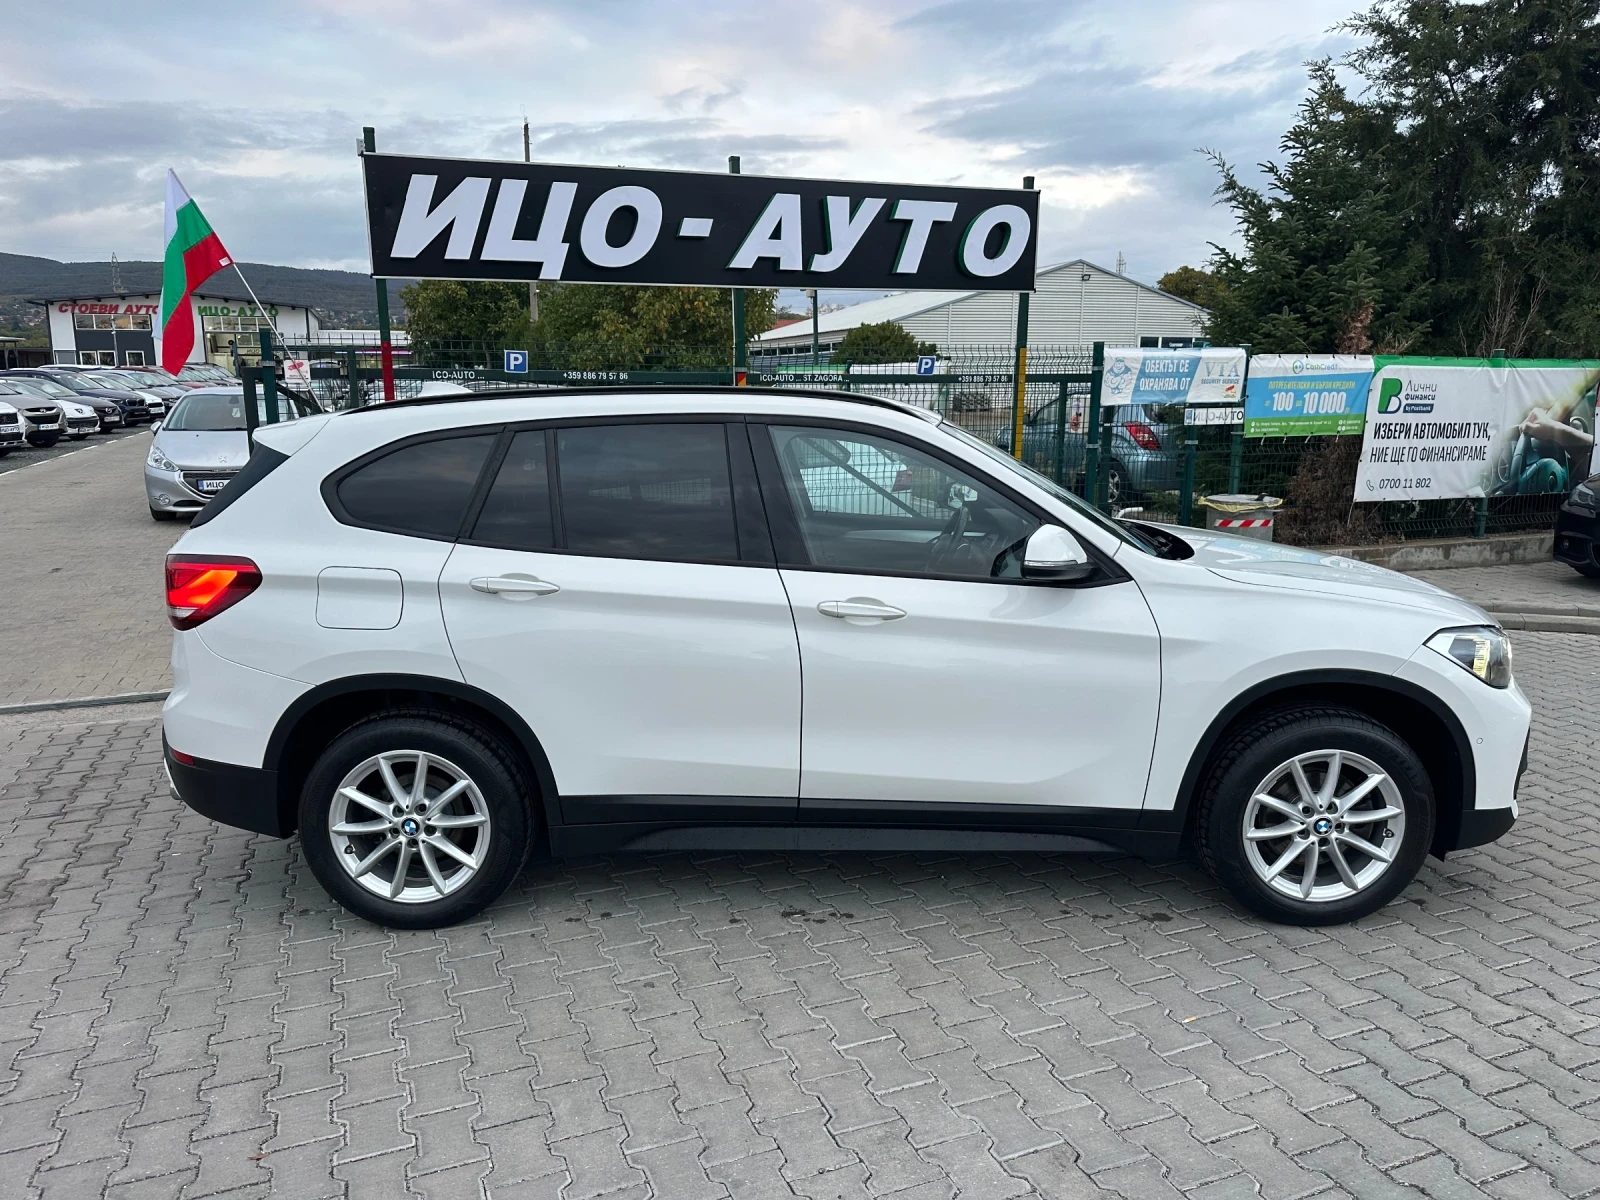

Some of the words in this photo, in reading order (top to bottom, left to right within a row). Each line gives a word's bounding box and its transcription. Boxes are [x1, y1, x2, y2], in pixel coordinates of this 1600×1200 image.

[391, 173, 663, 280] ИЦО
[726, 192, 1032, 278] АУТО
[58, 302, 120, 314] СТОЕВИ
[197, 305, 279, 317] ИЦО-АУТО
[509, 353, 523, 370] P
[921, 359, 932, 371] P
[1145, 360, 1179, 373] ОБЕКТЪТ
[1179, 359, 1190, 372] СЕ
[562, 371, 581, 380] +359
[583, 372, 597, 380] 886
[598, 372, 607, 380] 79
[1204, 361, 1241, 377] VTA
[814, 374, 843, 383] ZAGORA
[1139, 377, 1179, 391] ОХРАНЯВА
[1179, 377, 1191, 391] ОТ
[1405, 380, 1437, 392] Лични
[1272, 391, 1295, 412] 100
[1373, 423, 1411, 440] ИЗБЕРИ
[1412, 422, 1473, 440] АВТОМОБИЛ
[1473, 422, 1491, 442] ТУК,
[1370, 447, 1389, 464] НИЕ
[1390, 446, 1406, 466] ЩЕ
[1406, 446, 1418, 463] ГО
[1418, 445, 1487, 463] ФИНАНСИРАМЕ
[1379, 478, 1401, 490] 0700
[1402, 478, 1413, 489] 11
[1415, 478, 1431, 489] 802
